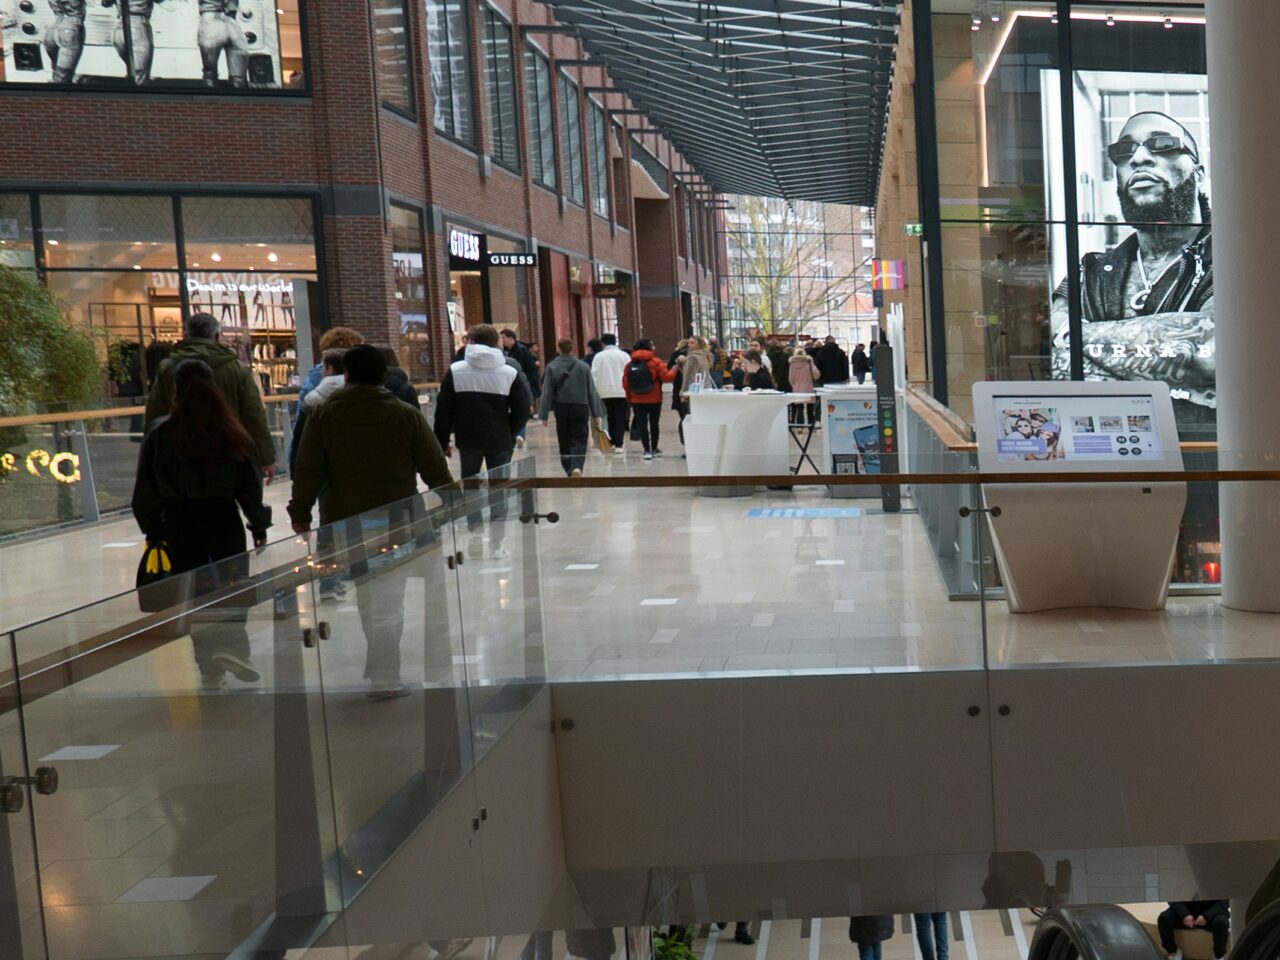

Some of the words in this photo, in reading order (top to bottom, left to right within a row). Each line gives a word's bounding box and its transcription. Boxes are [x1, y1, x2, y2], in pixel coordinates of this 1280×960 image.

[450, 229, 480, 262] GUESS
[490, 255, 534, 265] GUESS
[1088, 344, 1177, 358] URNA
